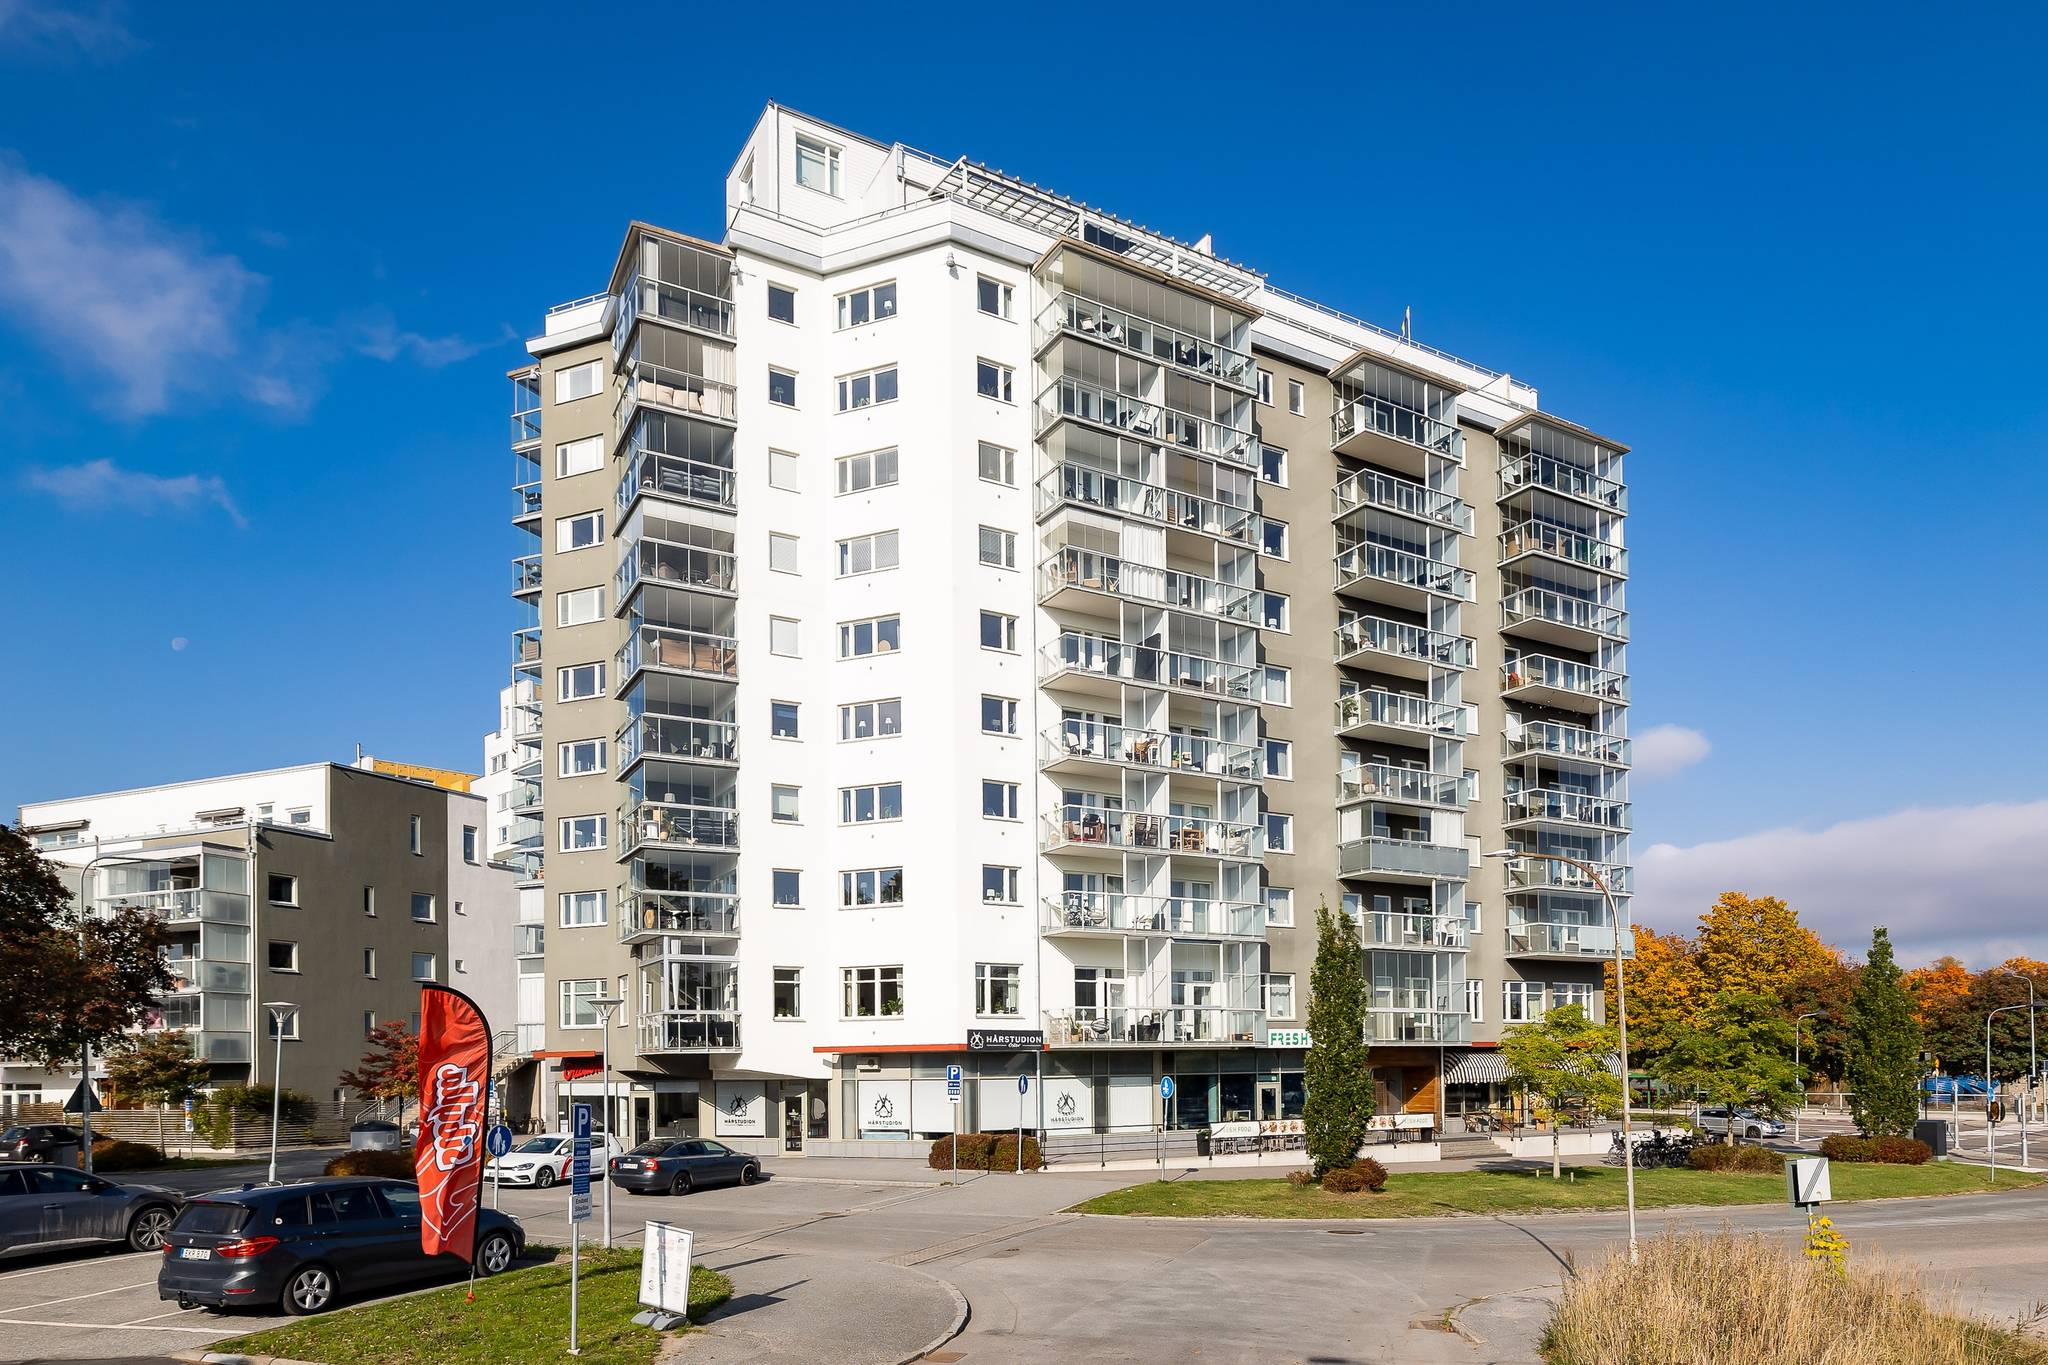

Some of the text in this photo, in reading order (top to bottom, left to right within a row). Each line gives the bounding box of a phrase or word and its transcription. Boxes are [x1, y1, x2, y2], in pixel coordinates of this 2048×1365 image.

[986, 1034, 1042, 1044] HÅRSTUDION
[1270, 1033, 1308, 1046] FRESH
[951, 1067, 959, 1079] P
[578, 1108, 588, 1136] P
